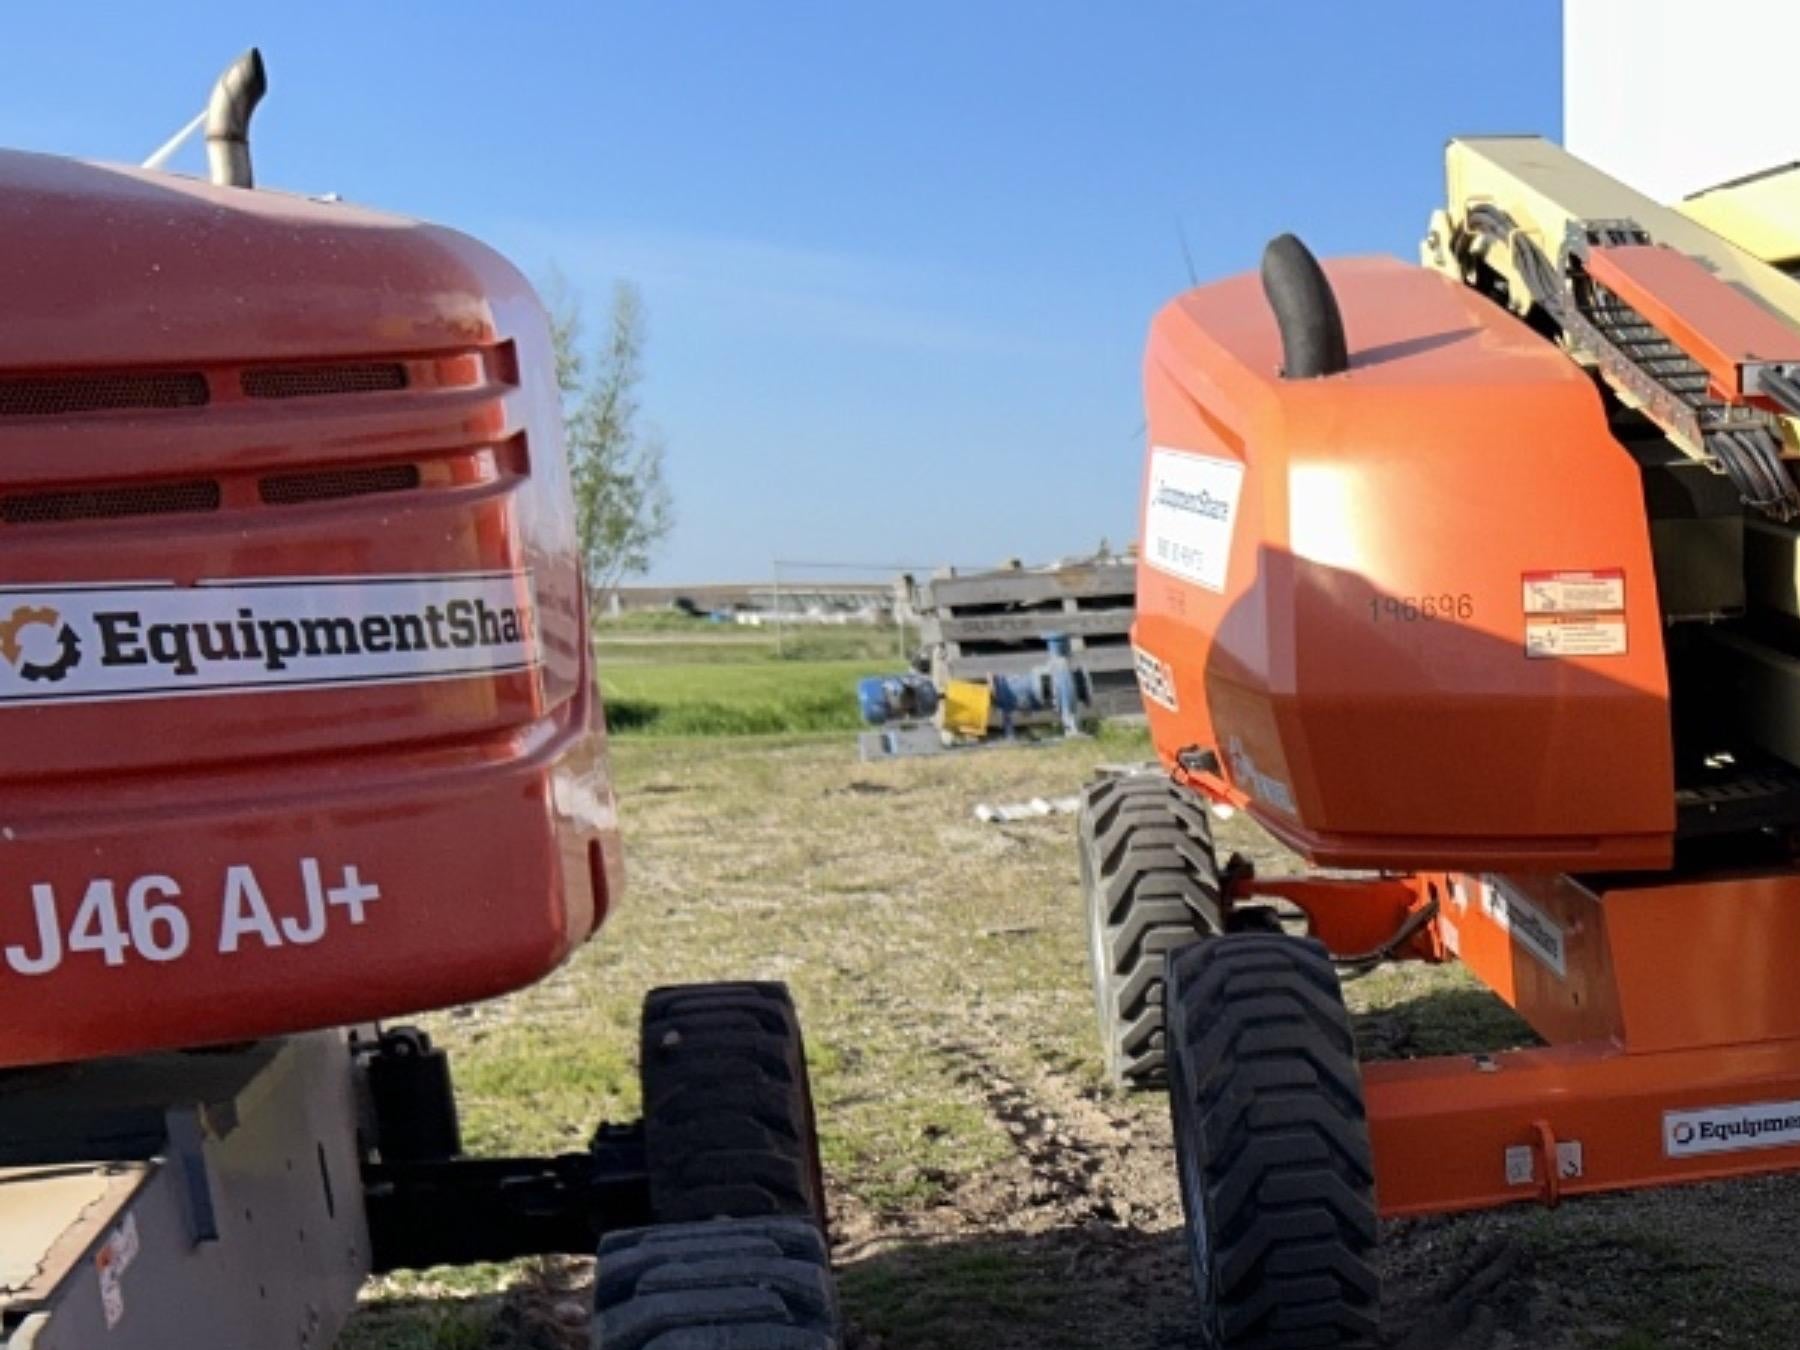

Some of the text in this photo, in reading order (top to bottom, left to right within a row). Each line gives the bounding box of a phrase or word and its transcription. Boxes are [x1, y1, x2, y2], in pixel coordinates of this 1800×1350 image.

[93, 599, 534, 676] EquipmentSha
[1367, 593, 1473, 622] 196696
[5, 857, 380, 975] J46 AJ+
